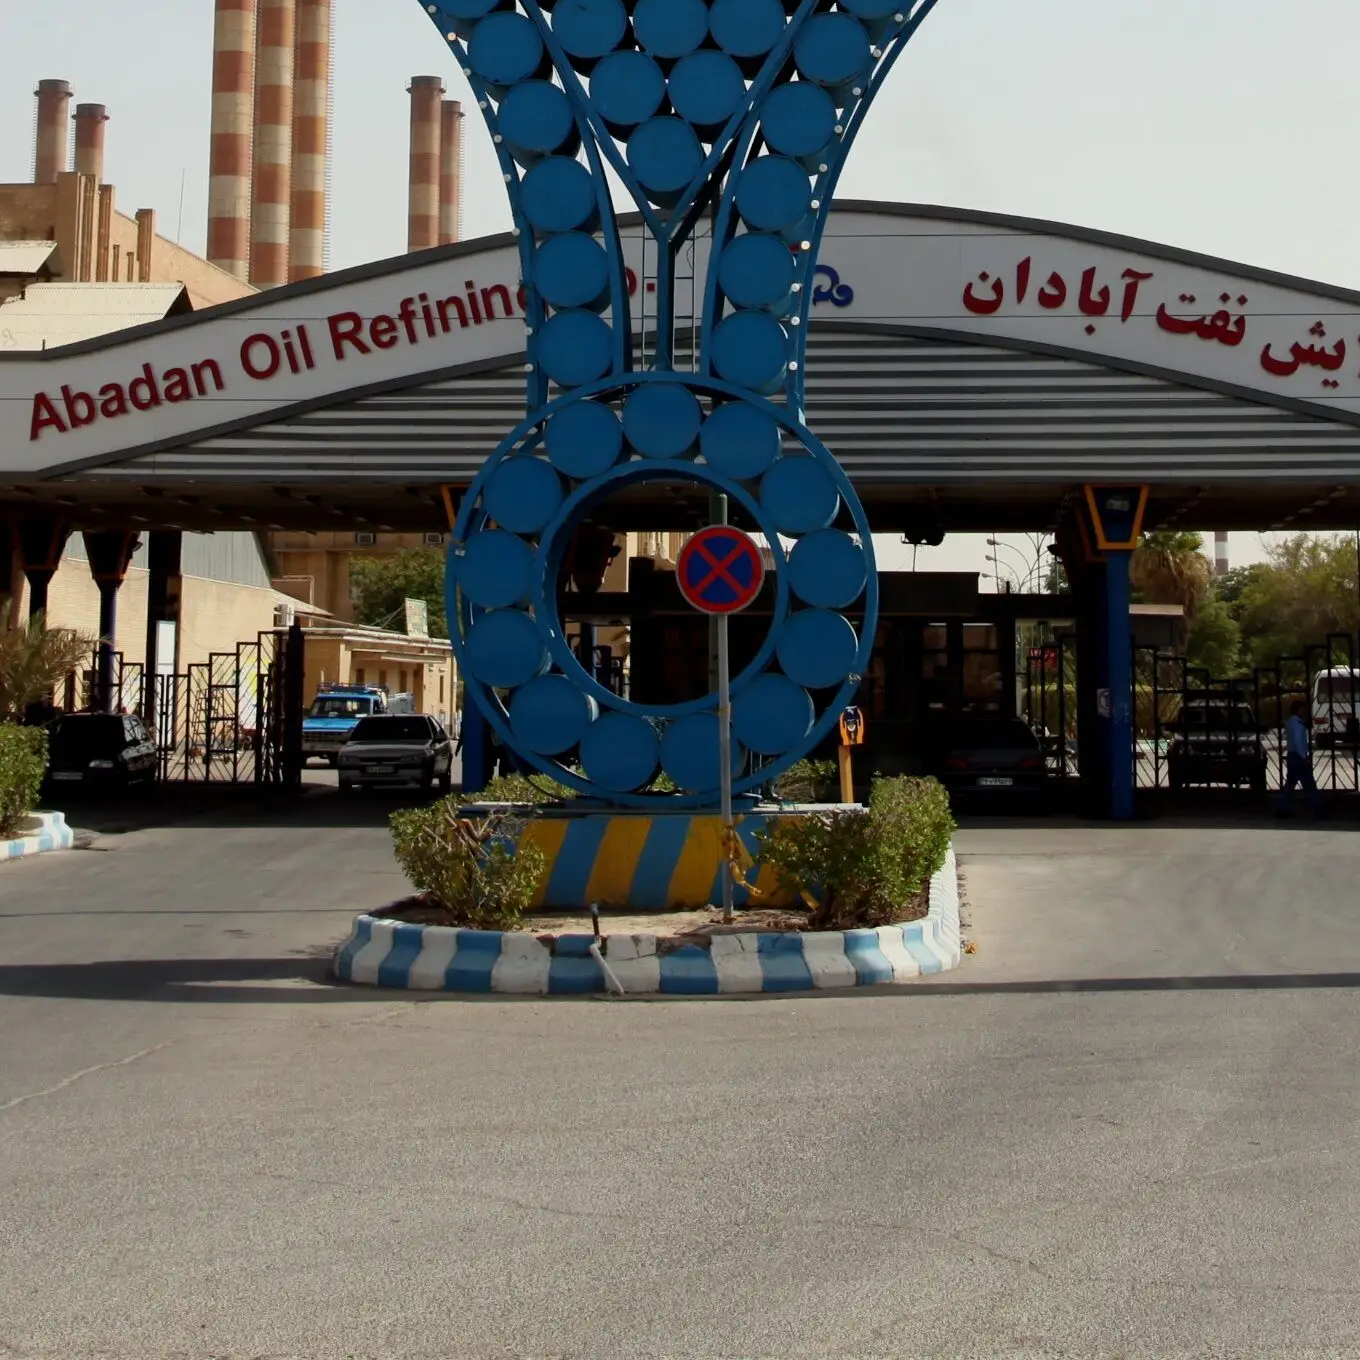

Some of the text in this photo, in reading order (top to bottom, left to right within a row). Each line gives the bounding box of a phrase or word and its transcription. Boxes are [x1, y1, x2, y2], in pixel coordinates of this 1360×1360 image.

[962, 256, 1154, 335] آبادان
[1156, 292, 1247, 346] نفت
[29, 362, 225, 441] Abadan
[240, 324, 316, 381] Oil
